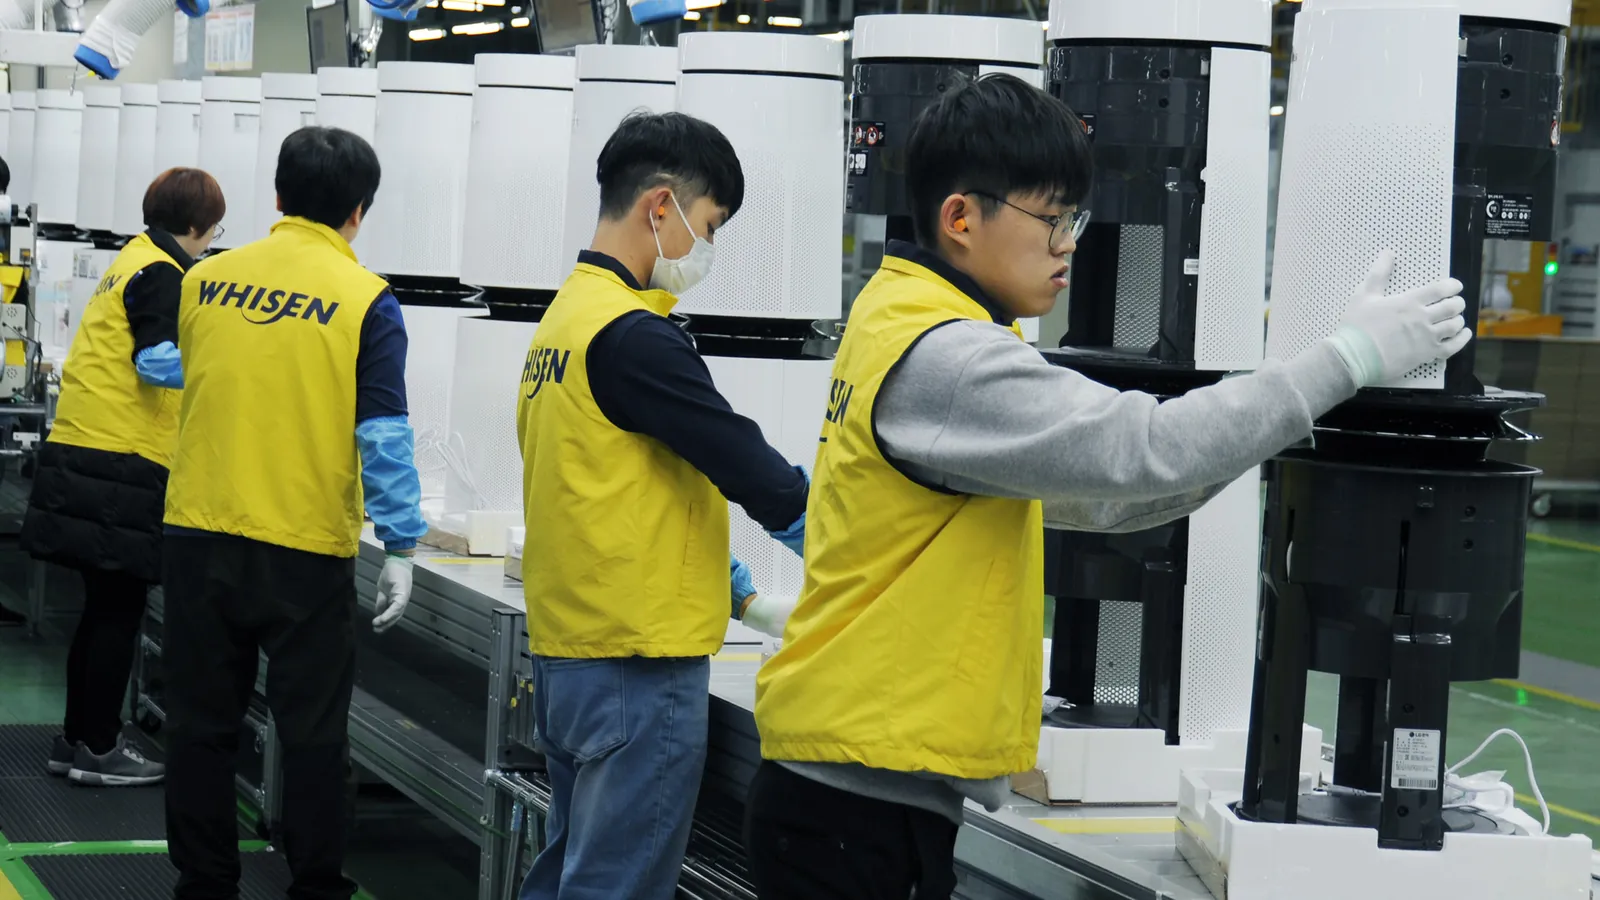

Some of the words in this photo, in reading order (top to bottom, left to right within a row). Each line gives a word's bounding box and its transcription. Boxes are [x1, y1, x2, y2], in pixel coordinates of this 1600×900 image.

[198, 279, 340, 326] WHISEN
[520, 347, 571, 400] HISEN
[825, 378, 855, 428] SEN
